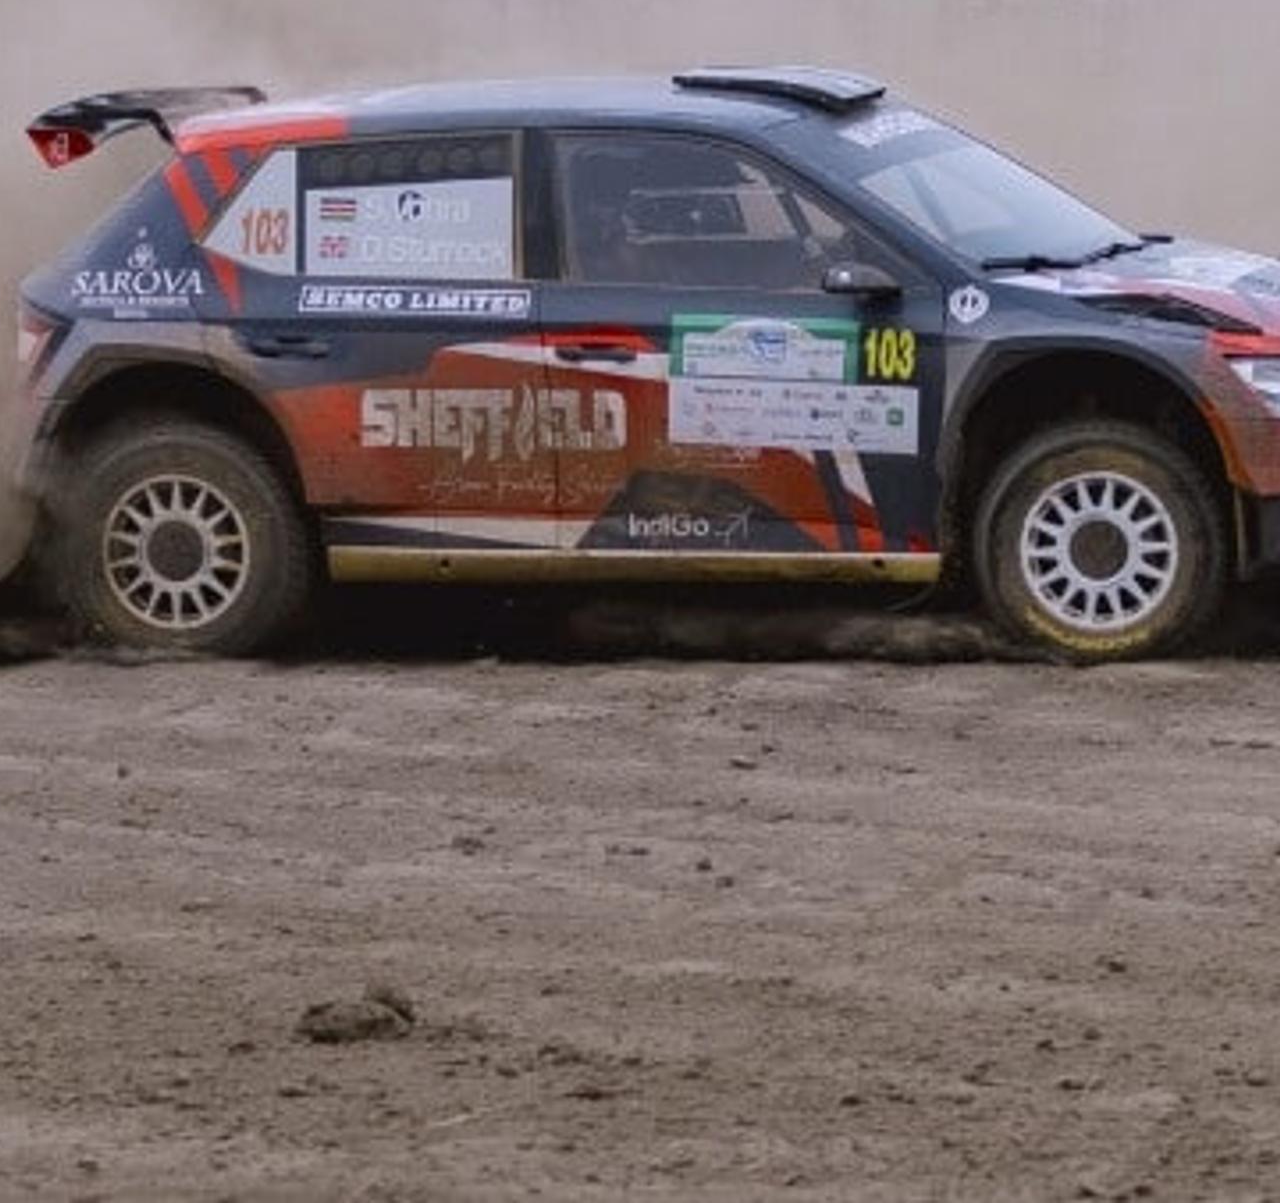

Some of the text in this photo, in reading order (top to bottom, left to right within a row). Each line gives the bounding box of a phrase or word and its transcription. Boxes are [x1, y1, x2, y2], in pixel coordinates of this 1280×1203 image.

[241, 207, 289, 255] 103
[71, 268, 205, 296] SAROVA
[408, 291, 525, 314] LIMITED
[864, 328, 916, 381] 103
[361, 385, 627, 461] SHEFFIELD
[628, 512, 709, 537] IndiGo
